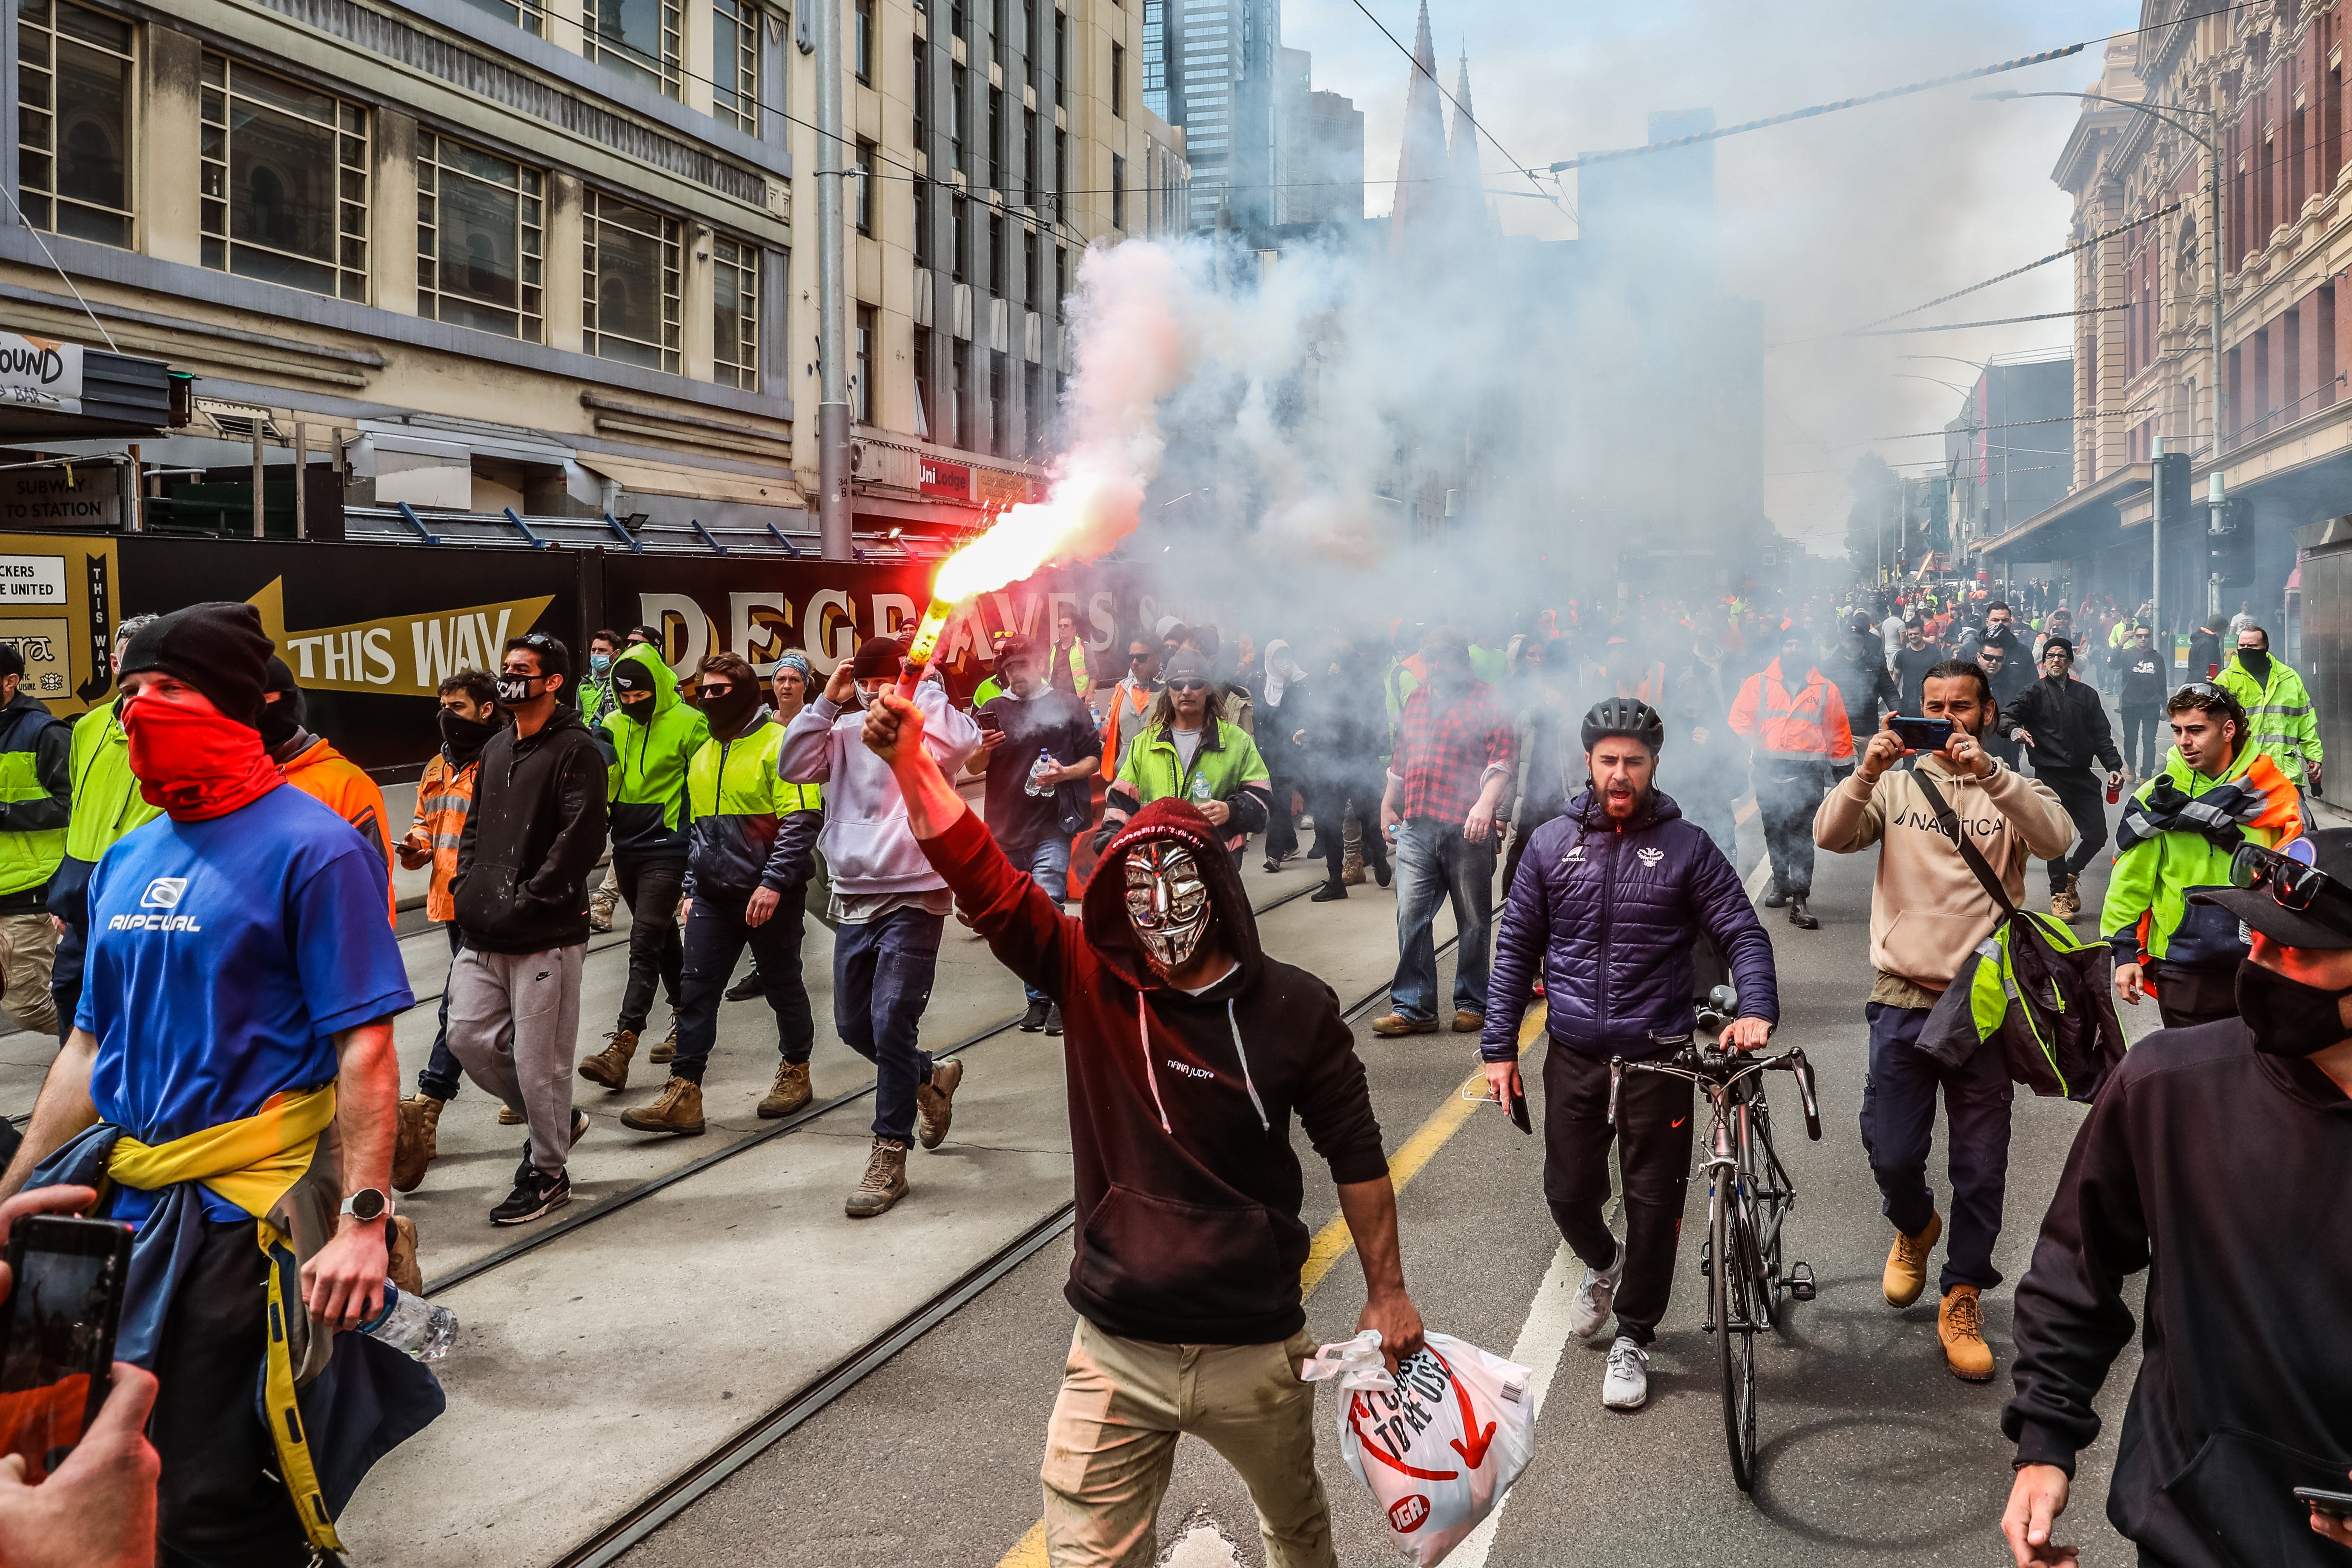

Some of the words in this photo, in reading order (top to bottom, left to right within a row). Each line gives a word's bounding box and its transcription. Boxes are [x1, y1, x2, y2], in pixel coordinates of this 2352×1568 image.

[0, 348, 63, 384] OUND
[16, 479, 85, 495] SUBWAY
[838, 478, 848, 486] 34
[920, 464, 966, 491] UniLodge
[5, 504, 27, 519] TO
[32, 501, 101, 517] STATION
[11, 583, 54, 595] UNITED
[93, 568, 103, 623] THIS
[94, 635, 106, 677] WAY
[287, 628, 396, 685] THIS
[411, 609, 512, 687] WAY
[1188, 1067, 1211, 1079] JUDY
[1374, 1415, 1411, 1462] TO
[1392, 1496, 1424, 1531] IGA
